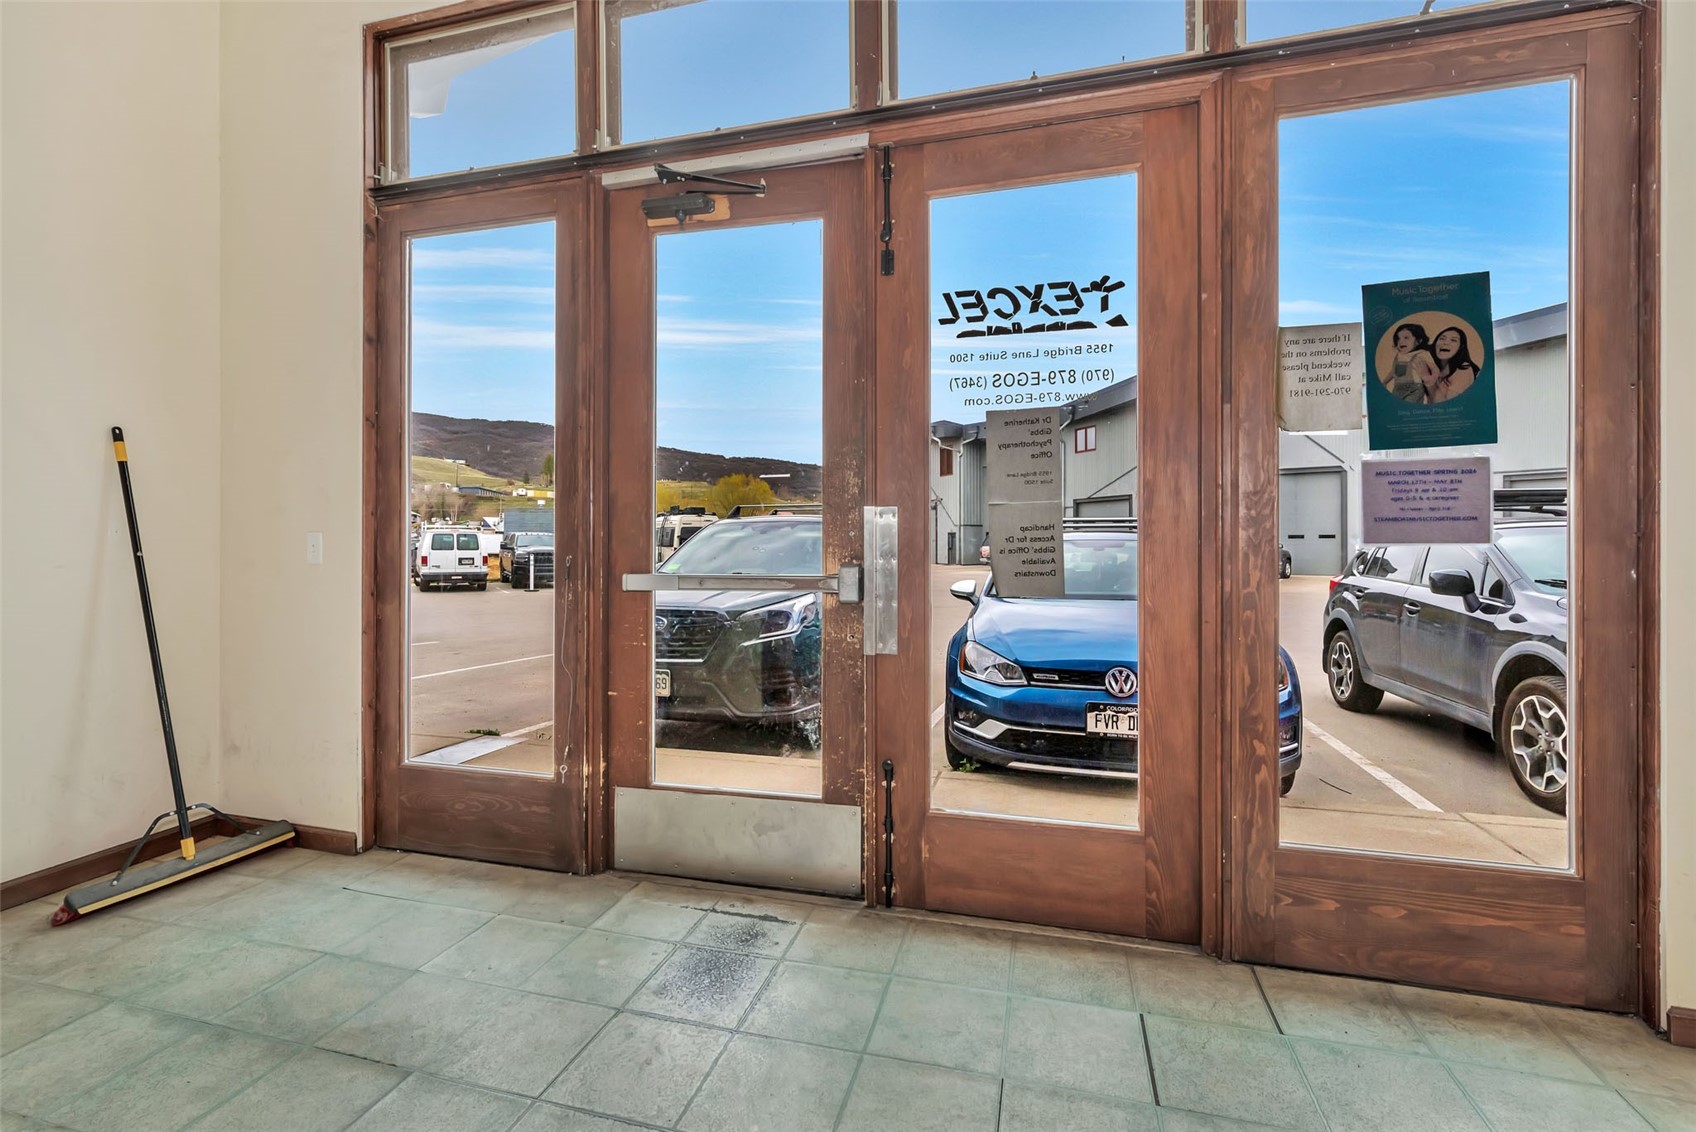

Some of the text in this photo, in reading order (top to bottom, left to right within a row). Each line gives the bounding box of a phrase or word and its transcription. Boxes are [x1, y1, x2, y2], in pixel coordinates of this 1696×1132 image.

[1392, 282, 1459, 297] Music Together
[1095, 714, 1138, 731] FVR D
